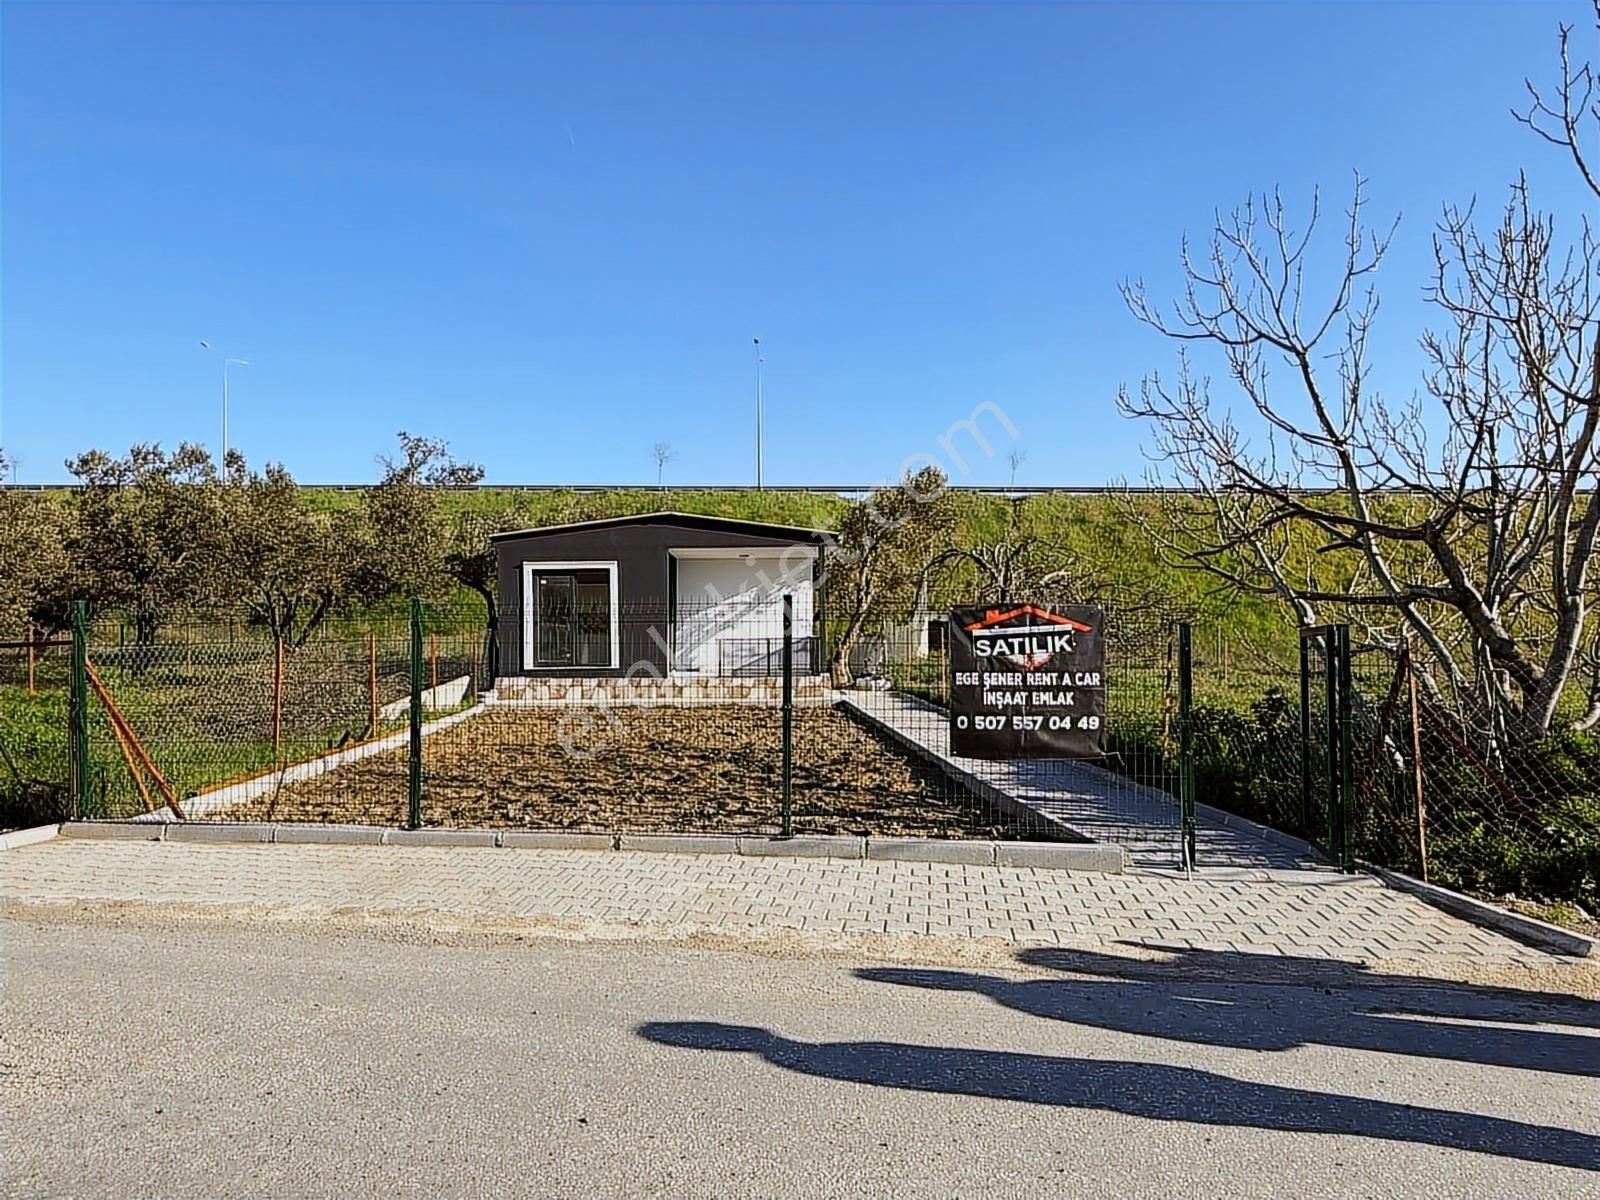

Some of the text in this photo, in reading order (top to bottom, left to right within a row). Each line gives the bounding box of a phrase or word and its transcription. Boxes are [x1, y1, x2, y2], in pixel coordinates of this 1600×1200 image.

[976, 635, 1072, 656] SATILIK
[955, 672, 1101, 689] EGE ŞENER RENT A CAR
[983, 688, 1074, 709] İNŞAAT EMLAK
[956, 715, 1100, 730] 0 507 557 04 49
